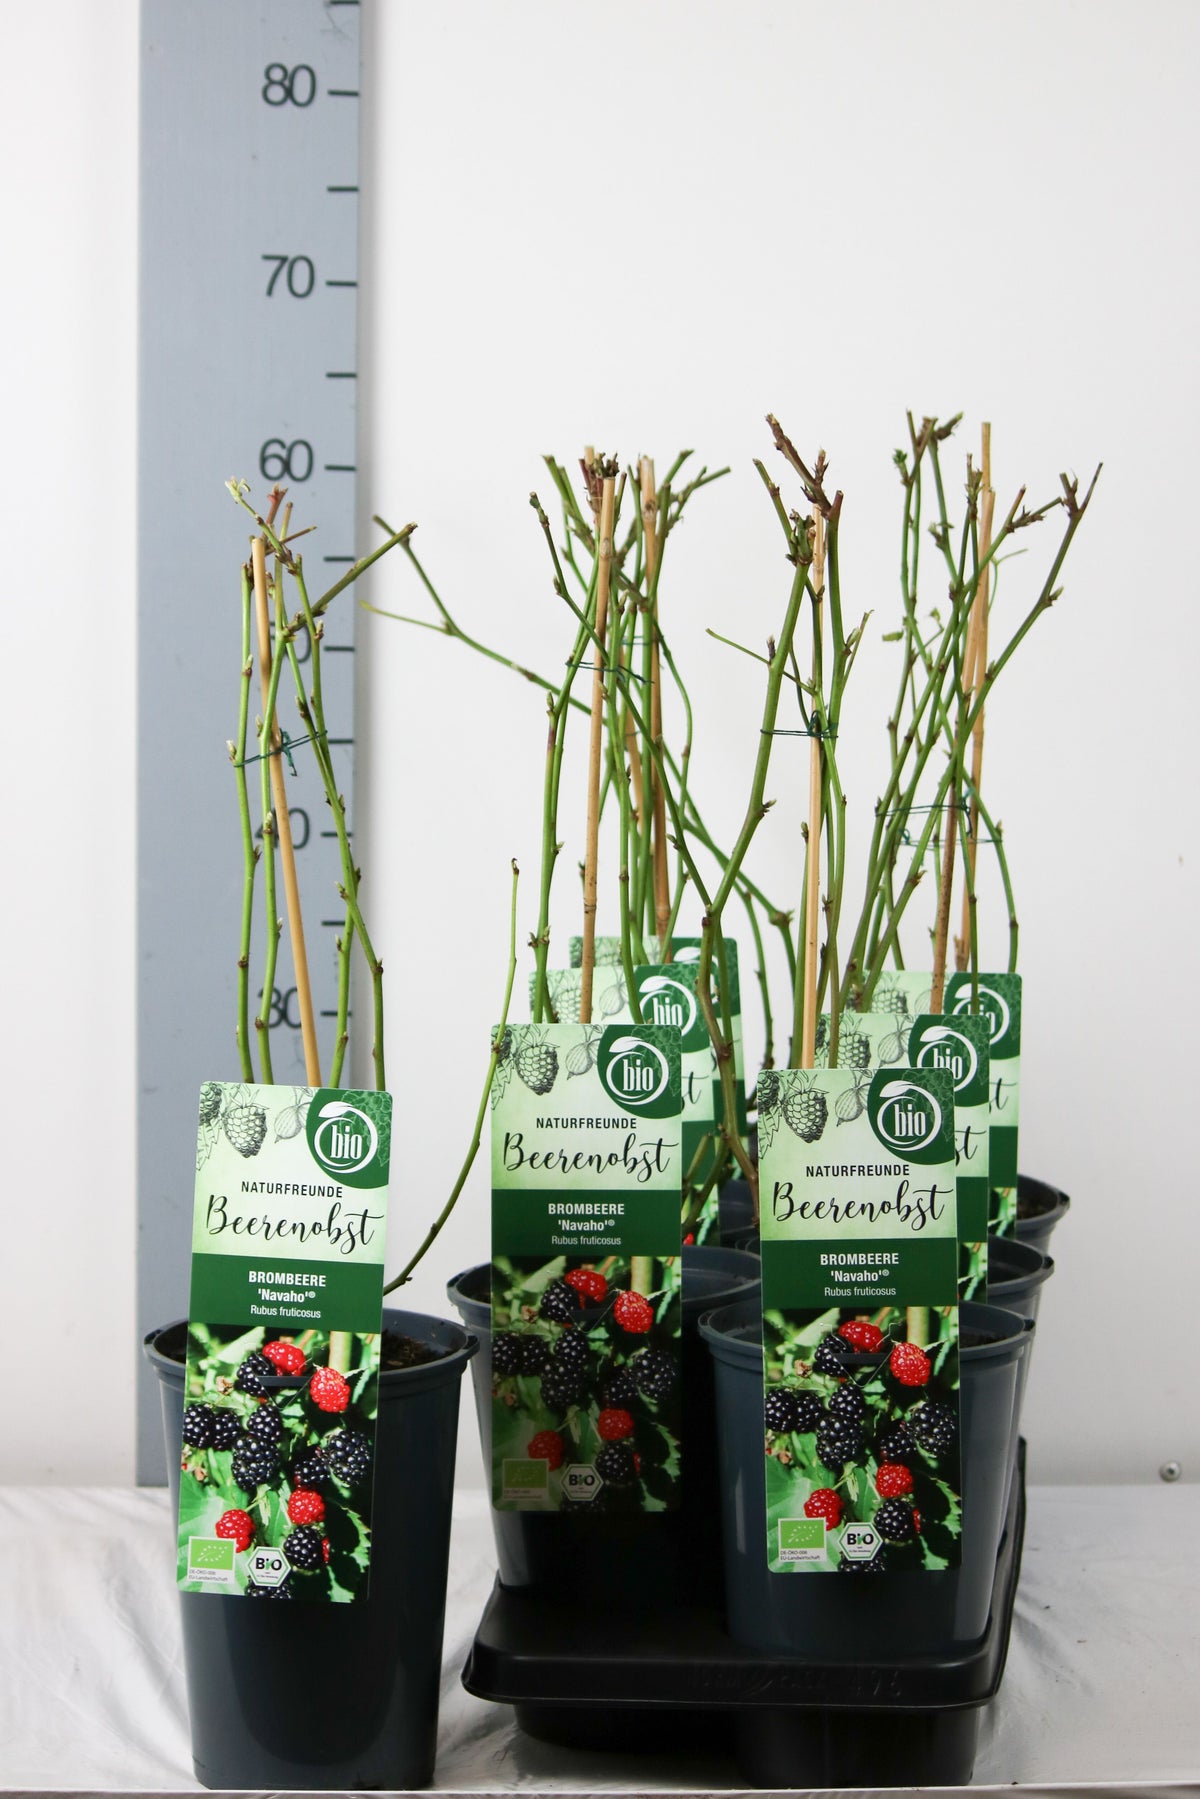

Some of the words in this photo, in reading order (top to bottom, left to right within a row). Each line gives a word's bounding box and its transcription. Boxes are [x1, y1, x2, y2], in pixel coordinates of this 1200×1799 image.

[262, 64, 317, 107] 80
[262, 255, 315, 298] 70
[259, 439, 313, 482] 60
[622, 1058, 654, 1092] bio
[536, 1117, 637, 1129] NATURFREUNDE
[894, 1103, 926, 1138] bio
[330, 1125, 364, 1160] bio
[503, 1131, 679, 1183] Beerenobst
[806, 1163, 910, 1177] NATURFREUNDE
[241, 1181, 343, 1198] NATURFREUNDE
[548, 1203, 625, 1215] BROMBEERE
[772, 1179, 954, 1231] Beerenobst
[206, 1194, 384, 1255] Beerenobst
[551, 1235, 578, 1245] Rubus
[580, 1234, 622, 1245] fruticosus
[820, 1253, 899, 1266] BROMBEERE
[248, 1270, 327, 1287] BROMBEERE
[824, 1286, 852, 1297] Rubus
[853, 1285, 897, 1297] fruticosus
[250, 1304, 277, 1316] Rubus
[279, 1305, 321, 1319] fruticosus
